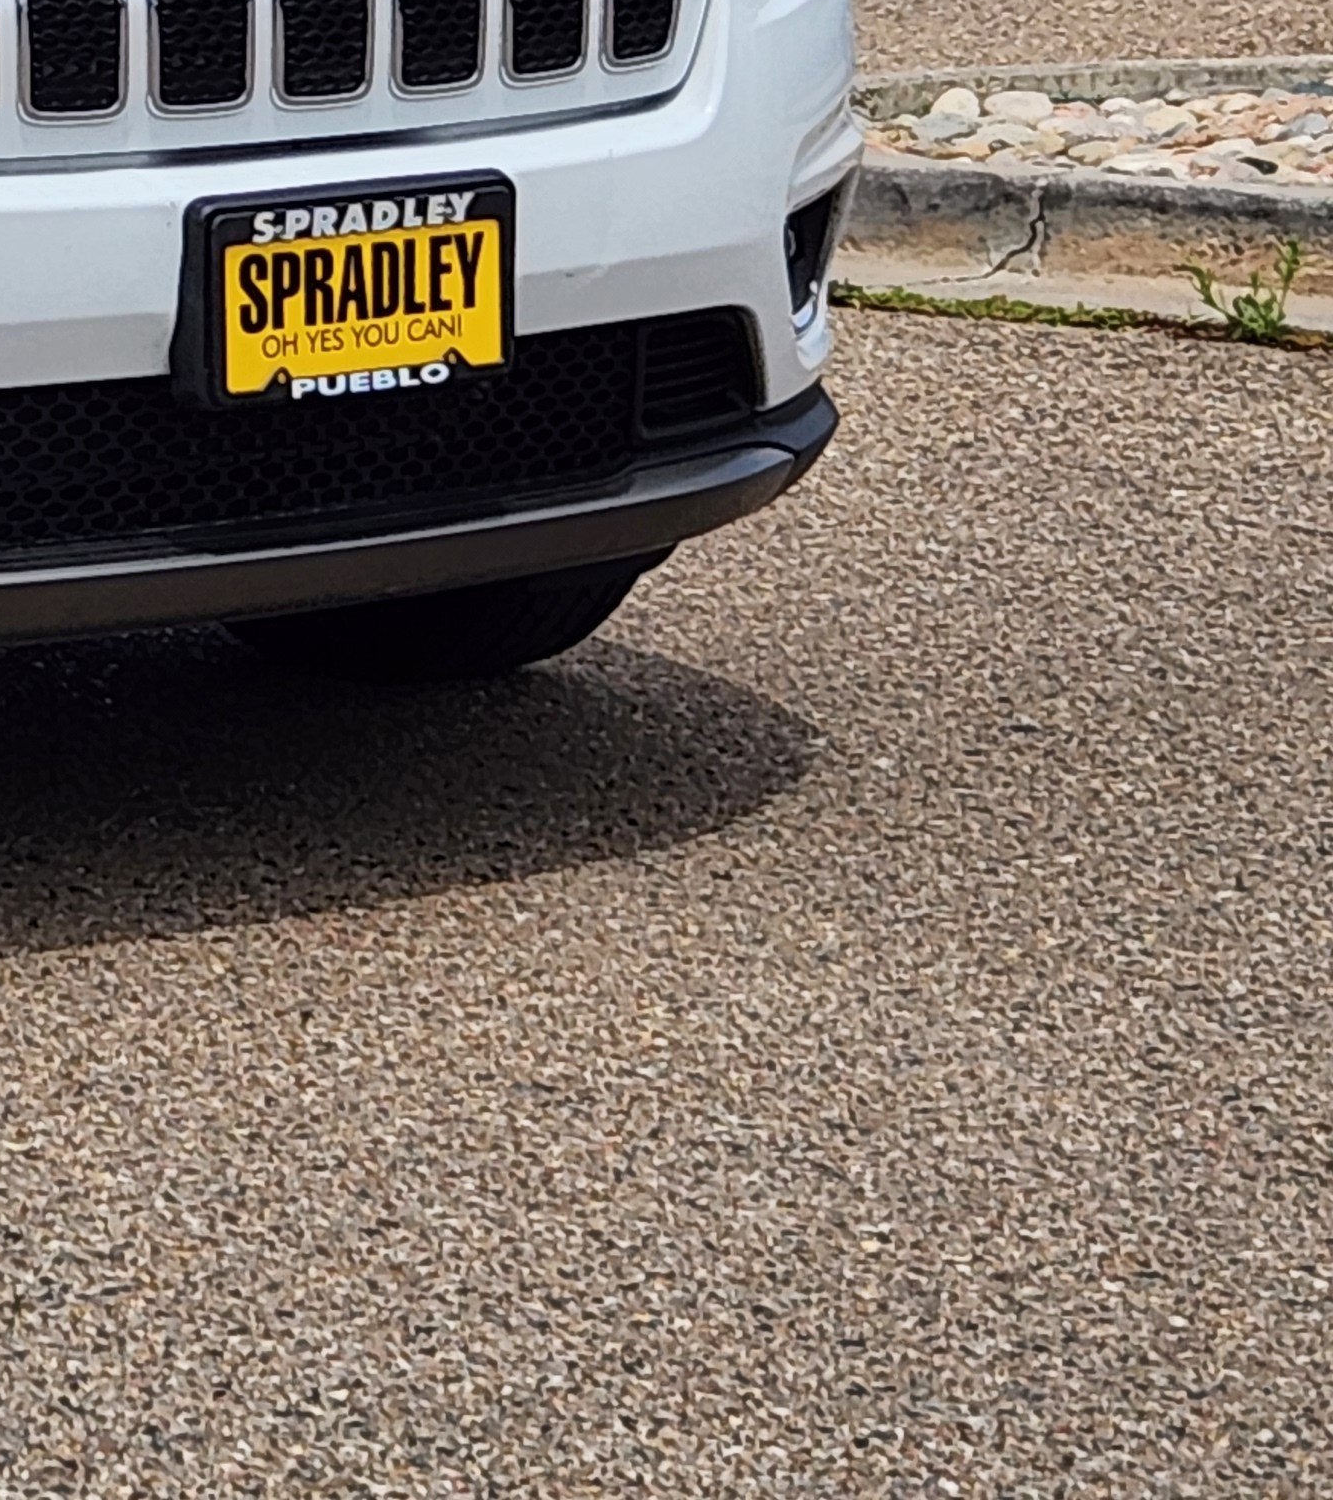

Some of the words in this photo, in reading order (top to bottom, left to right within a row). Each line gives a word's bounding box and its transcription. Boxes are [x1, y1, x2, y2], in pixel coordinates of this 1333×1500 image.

[238, 231, 485, 334] SPRADLEY
[261, 333, 299, 358] OH
[307, 329, 344, 353] YES
[351, 322, 399, 347] YOU
[291, 363, 449, 399] PUEBLO
